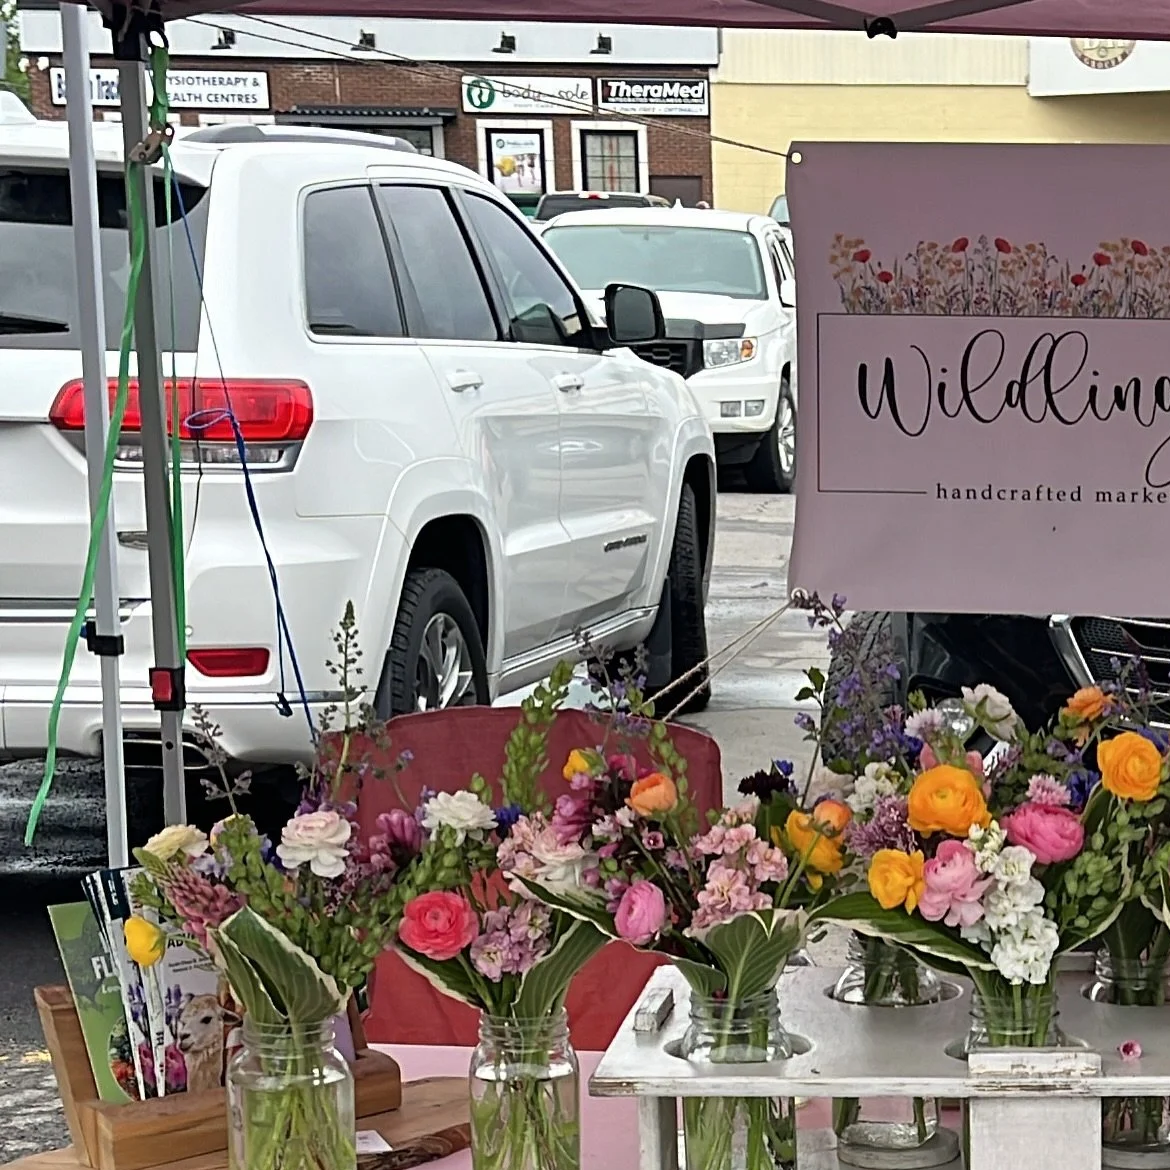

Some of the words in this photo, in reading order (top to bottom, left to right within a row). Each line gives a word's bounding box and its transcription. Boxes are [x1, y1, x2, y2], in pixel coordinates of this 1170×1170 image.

[168, 76, 249, 86] YSIOTHERAPY
[607, 81, 704, 98] TheraMed
[167, 93, 202, 102] EALTH
[206, 94, 258, 103] CENTRES
[936, 483, 1082, 502] handcrafted
